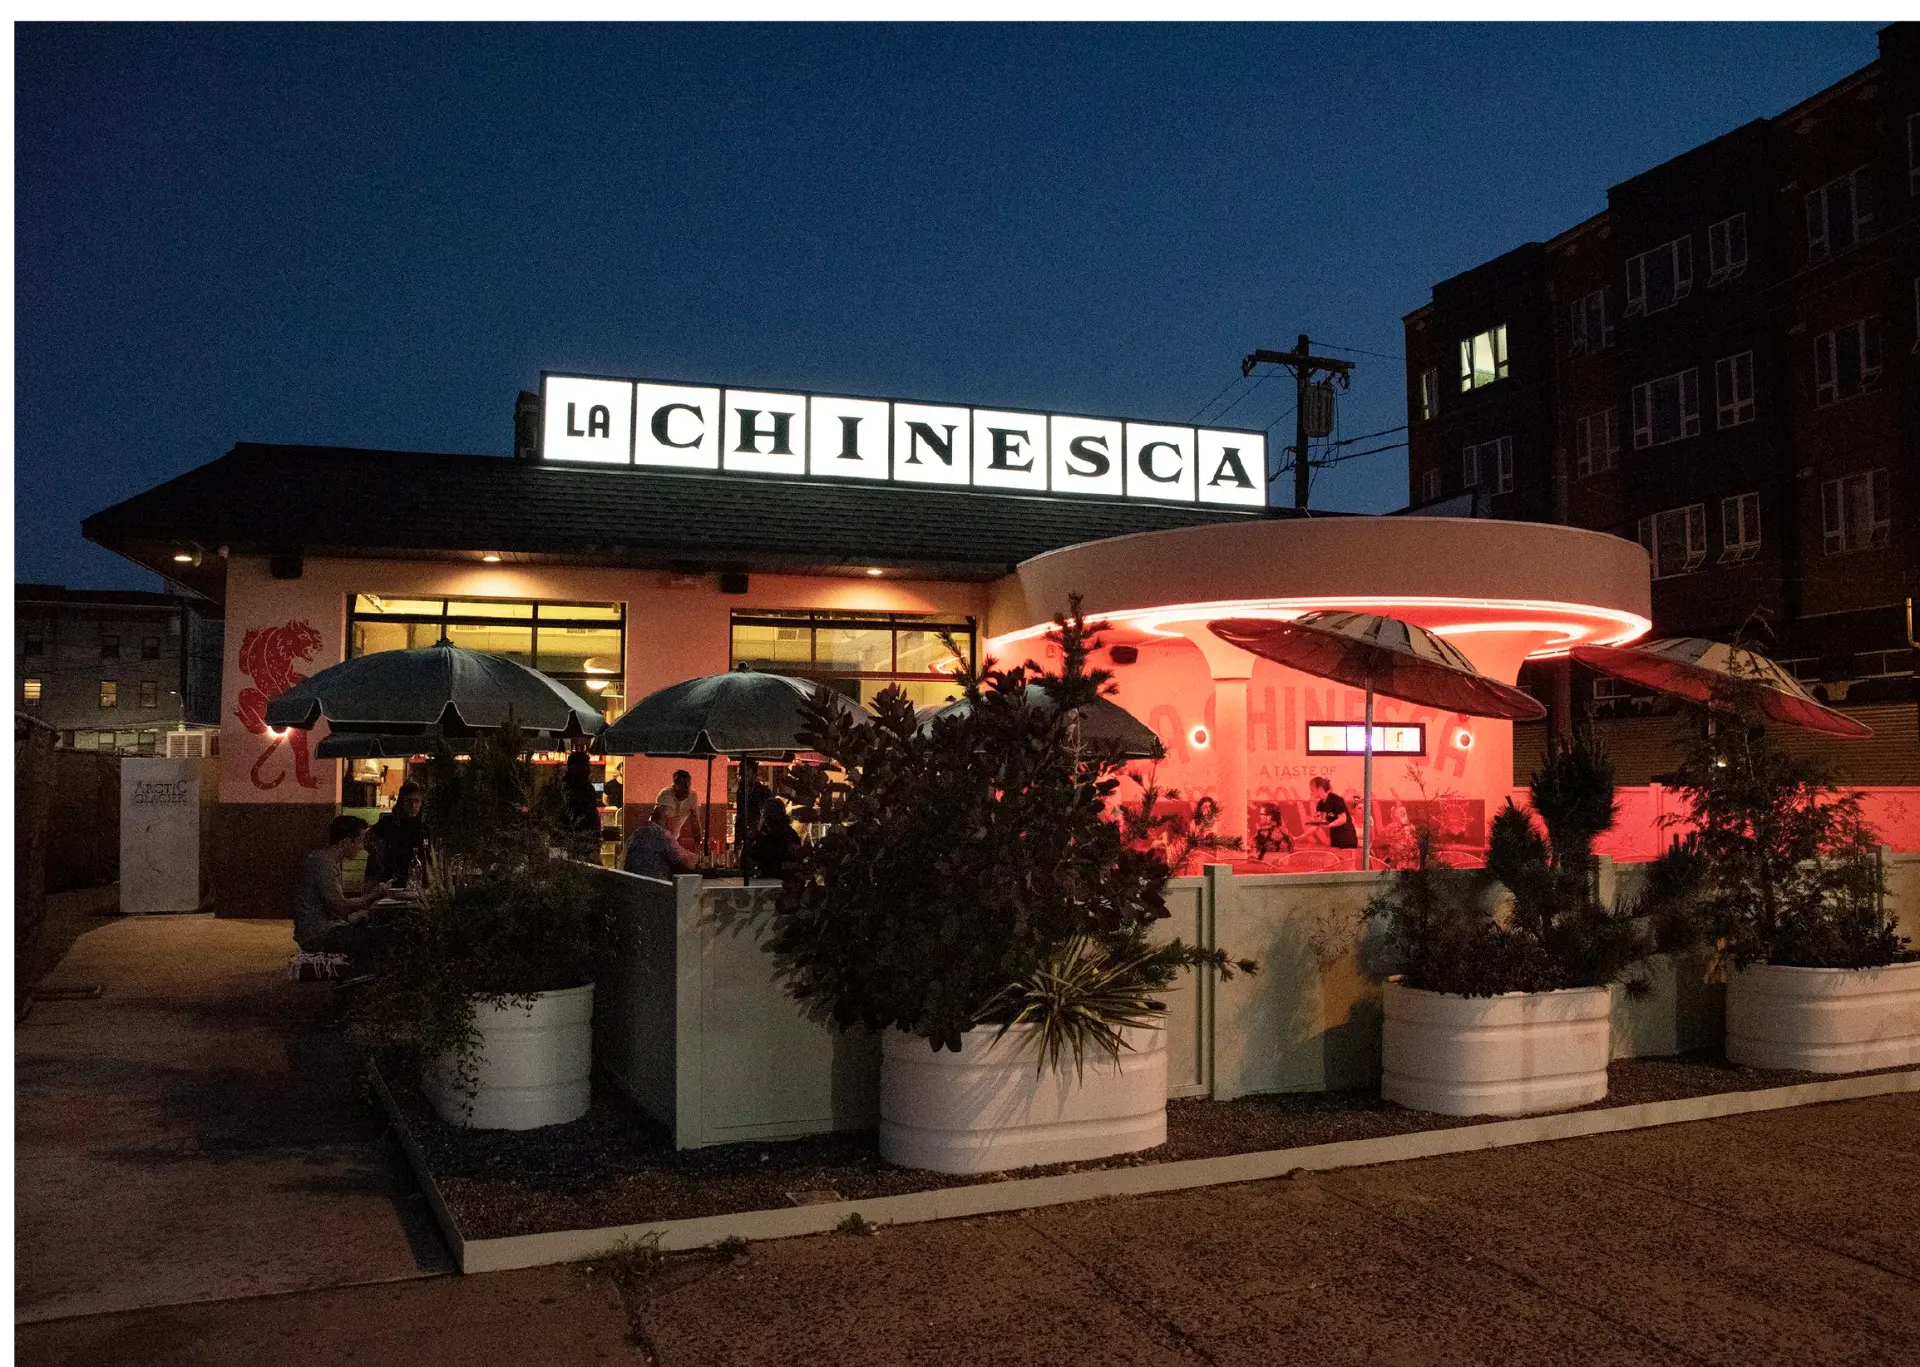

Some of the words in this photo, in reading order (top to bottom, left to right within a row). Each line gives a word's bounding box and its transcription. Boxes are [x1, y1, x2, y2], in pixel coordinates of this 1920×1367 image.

[566, 402, 610, 439] LA
[650, 402, 1257, 490] CHINESCA
[1259, 766, 1270, 776] A
[1274, 766, 1318, 777] TASTE
[1320, 766, 1337, 776] OF
